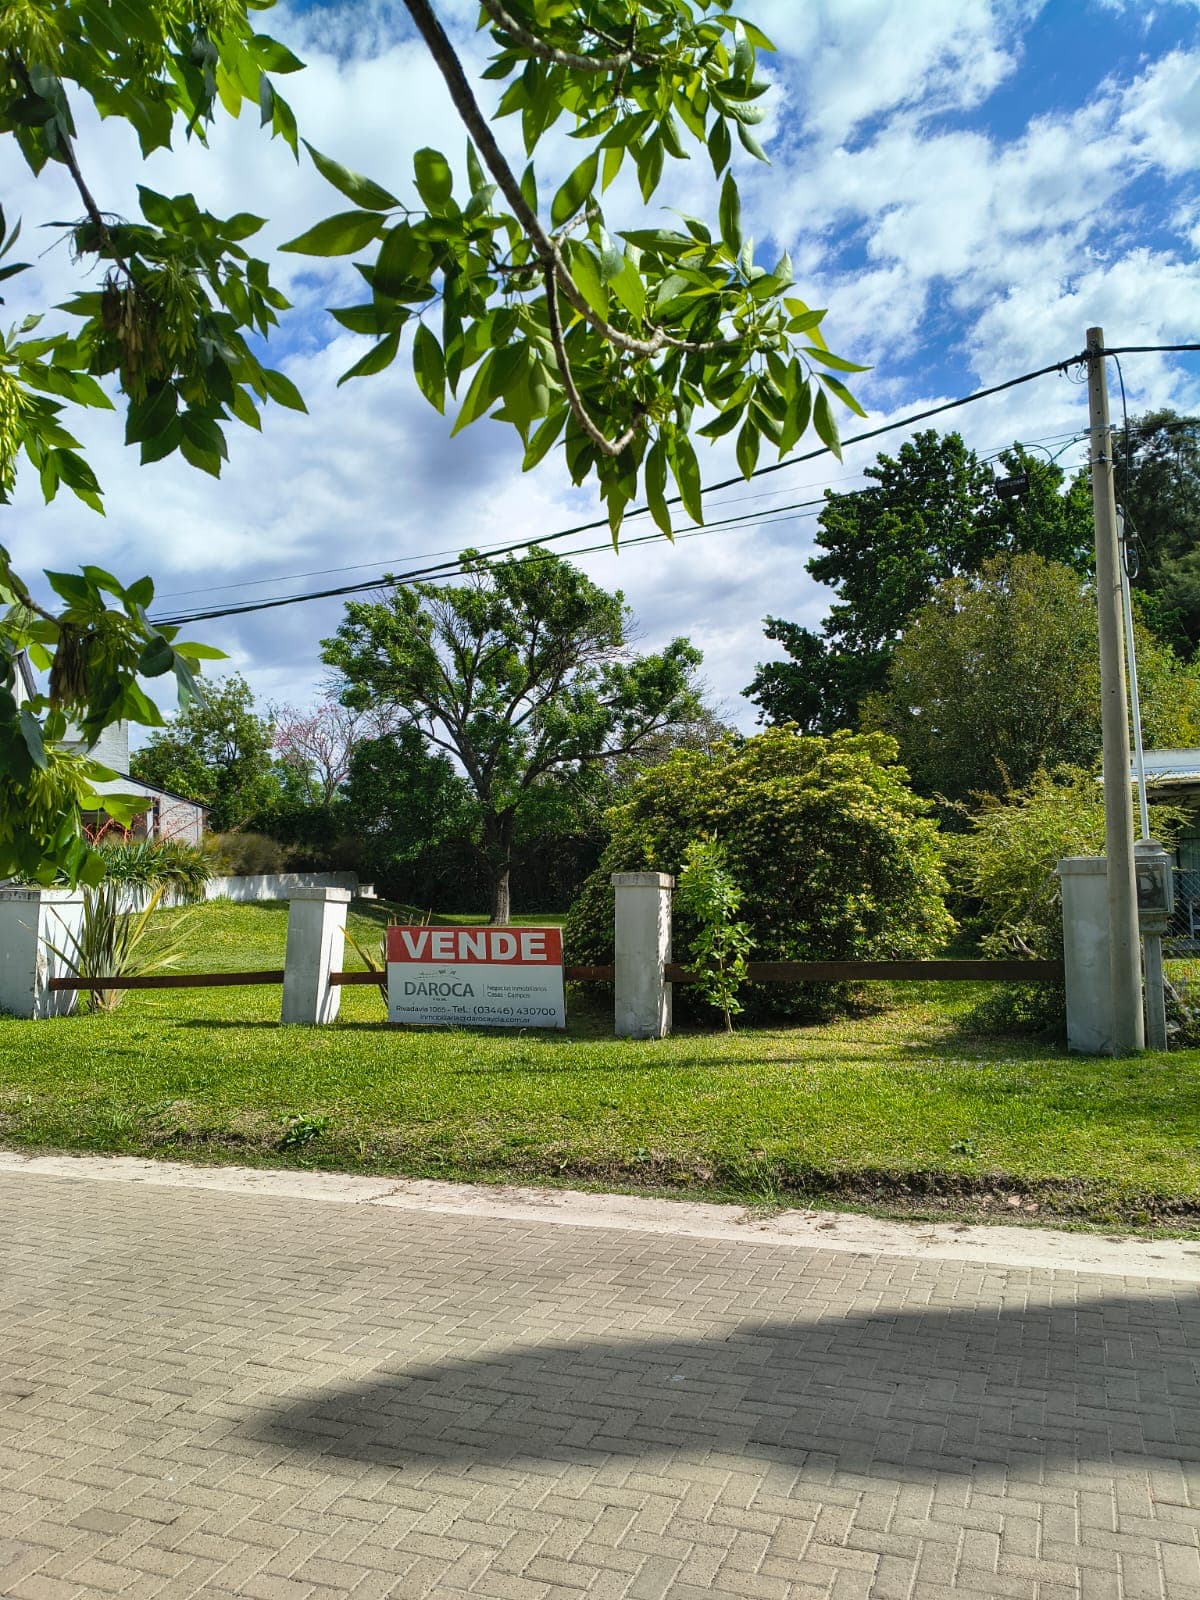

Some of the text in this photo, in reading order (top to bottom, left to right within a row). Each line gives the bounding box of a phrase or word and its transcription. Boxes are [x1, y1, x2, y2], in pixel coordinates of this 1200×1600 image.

[401, 930, 547, 961] VENDE
[404, 981, 475, 997] DAROCA
[395, 1004, 429, 1012] Rivadavia
[473, 1006, 514, 1016] (03446)
[516, 1007, 556, 1016] 430700
